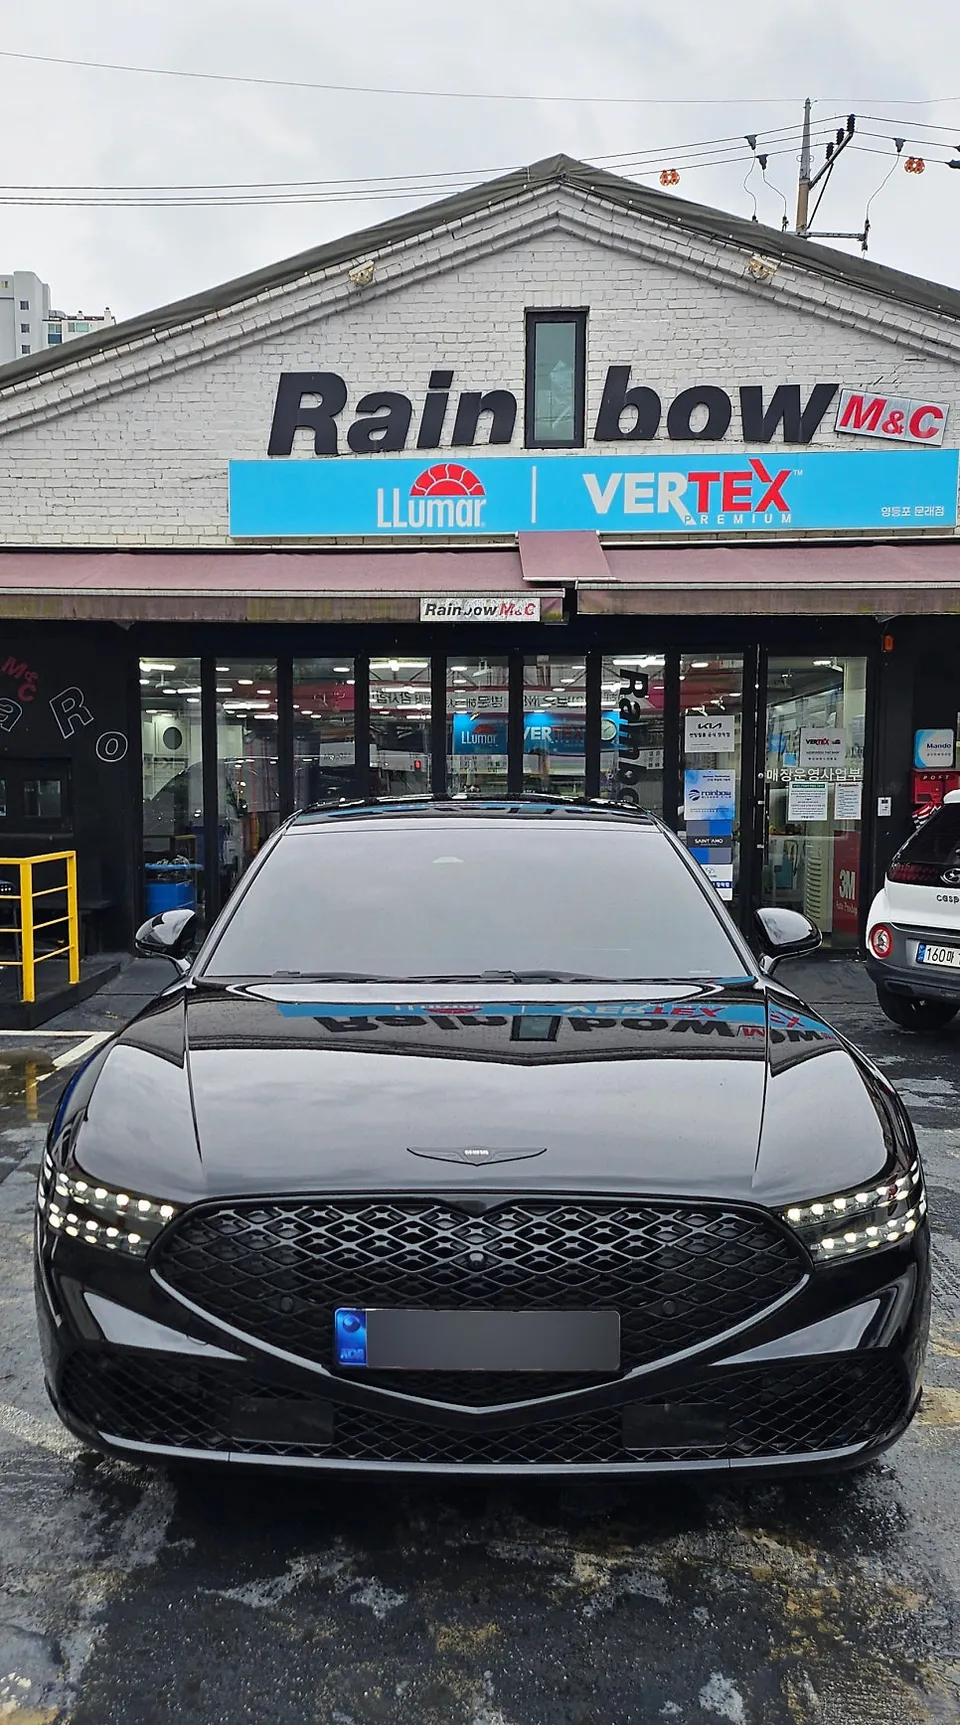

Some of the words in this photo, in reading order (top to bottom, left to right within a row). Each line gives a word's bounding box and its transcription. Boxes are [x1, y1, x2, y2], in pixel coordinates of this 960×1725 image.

[267, 370, 517, 456] Rain
[594, 365, 839, 443] bow
[839, 395, 944, 439] M&C
[377, 487, 486, 528] LLumar
[582, 458, 792, 525] VERTEX
[685, 513, 792, 525] PREMIUM
[881, 506, 911, 517] 영등포
[914, 506, 944, 517] 문래점
[766, 768, 863, 782] 매장운영사업부
[839, 868, 856, 900] 3M
